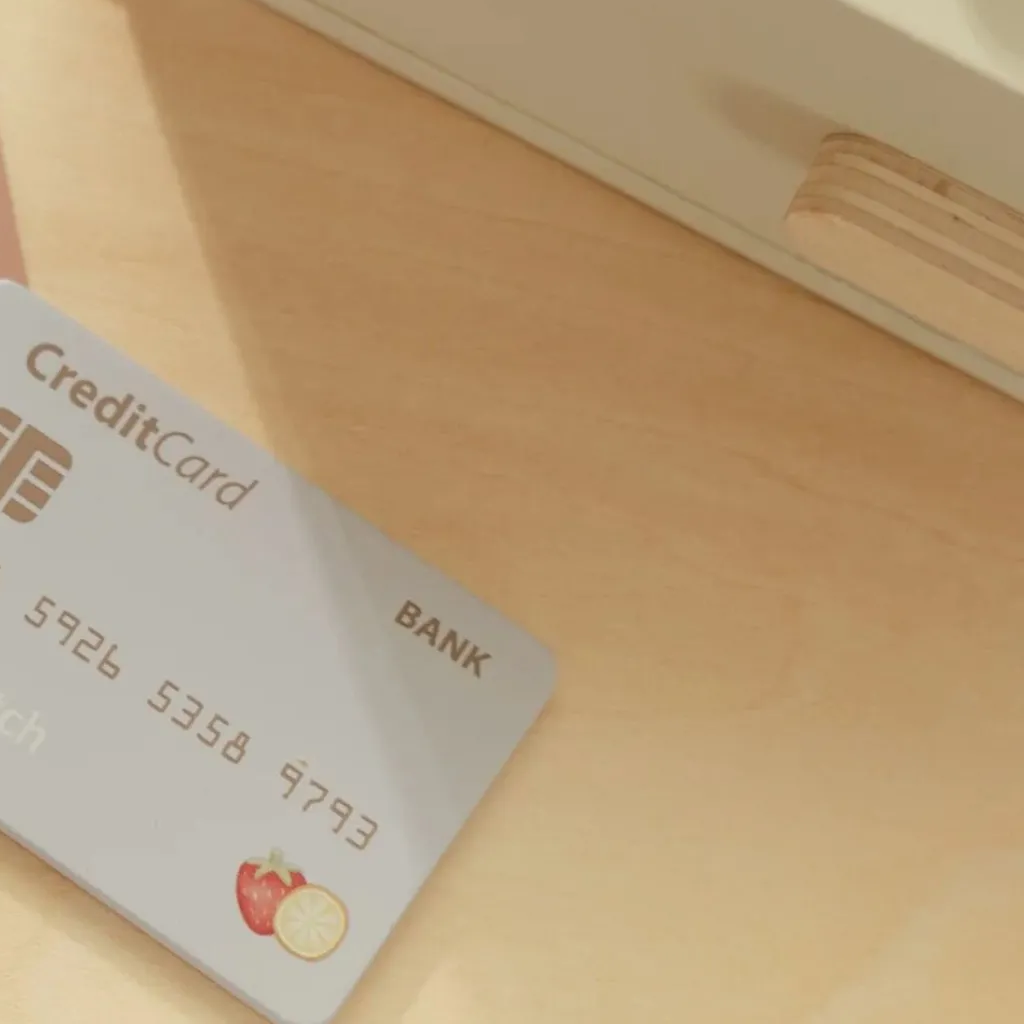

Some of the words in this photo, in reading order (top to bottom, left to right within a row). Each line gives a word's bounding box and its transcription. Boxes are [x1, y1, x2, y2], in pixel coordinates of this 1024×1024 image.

[26, 342, 260, 510] CreditCard
[394, 599, 493, 678] BANK
[24, 595, 121, 680] 5926
[147, 679, 251, 765] 5358
[280, 762, 379, 851] 9793
